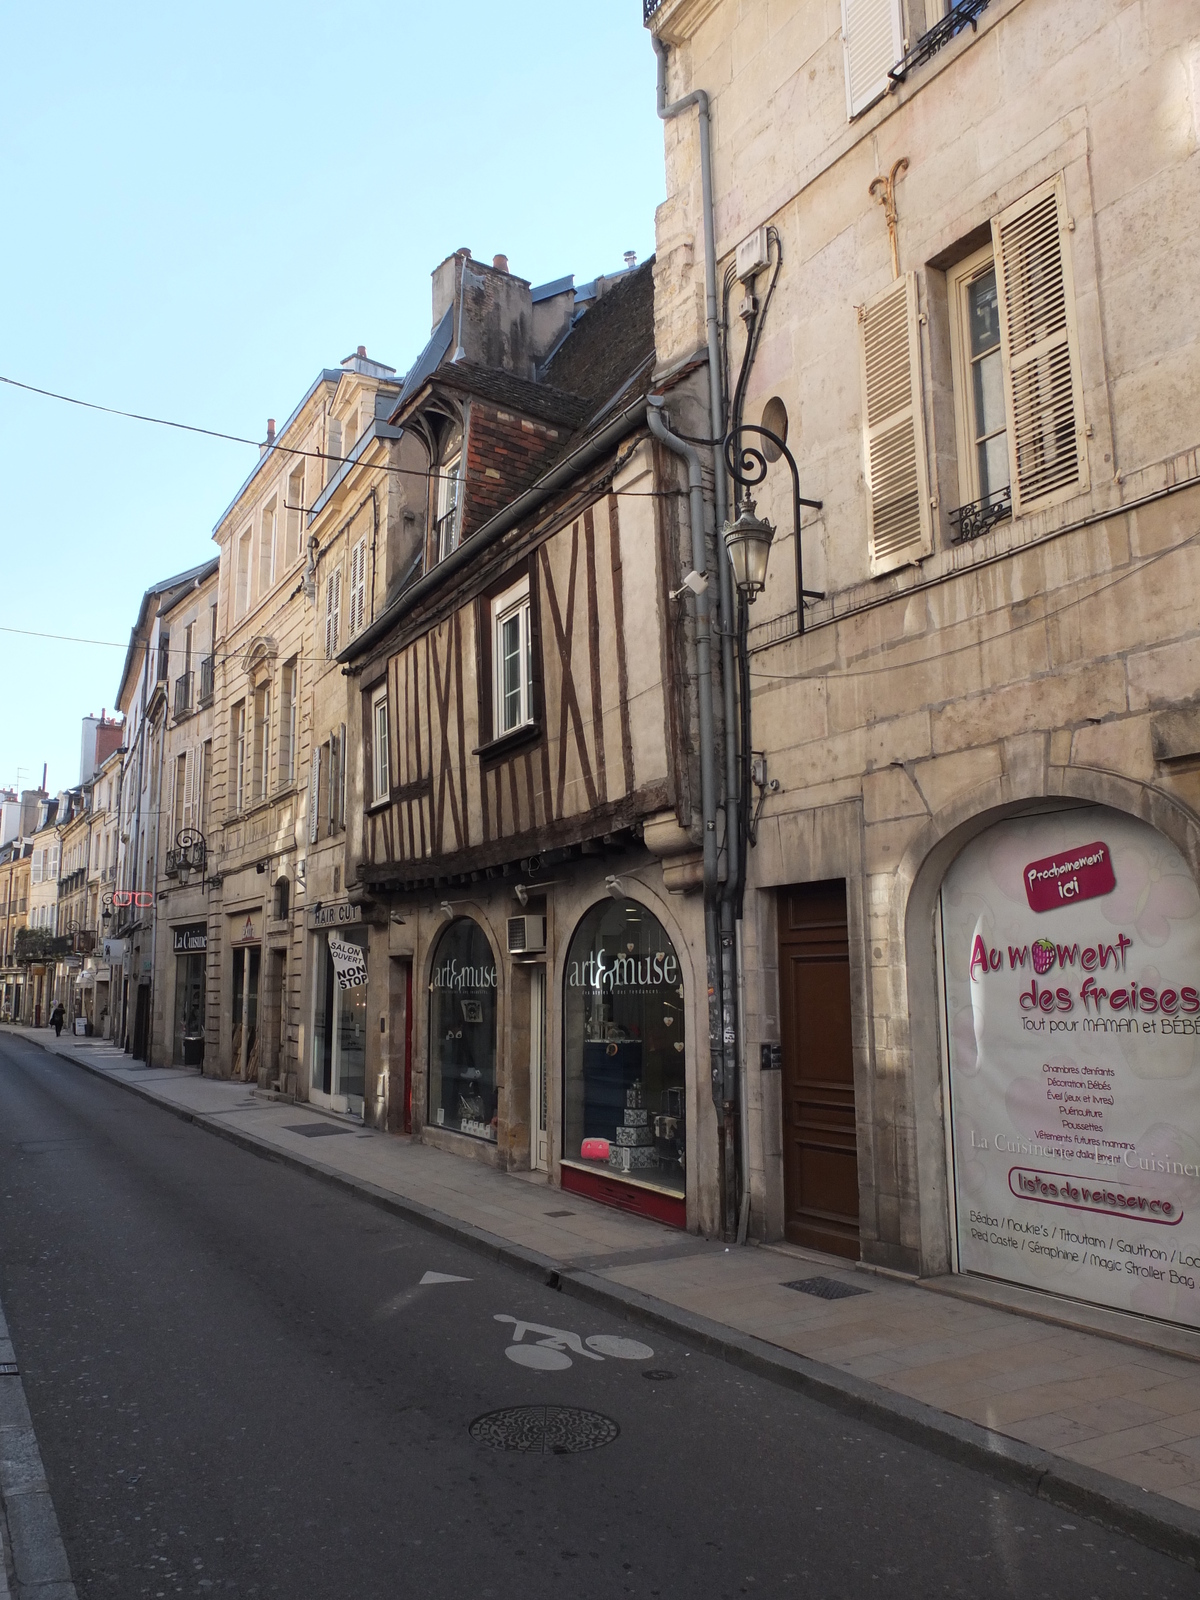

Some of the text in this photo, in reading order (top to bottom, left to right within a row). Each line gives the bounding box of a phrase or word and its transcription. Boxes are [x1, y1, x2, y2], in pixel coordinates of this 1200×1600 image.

[1027, 849, 1104, 891] Prochainement
[1057, 877, 1079, 898] ici
[315, 905, 358, 925] HAIR CUT
[174, 931, 183, 949] La
[330, 941, 360, 956] SALON
[332, 951, 362, 965] OUVERT
[970, 934, 1001, 982] Au
[336, 964, 366, 980] NON
[340, 974, 368, 990] STOP
[1019, 976, 1200, 1014] des fraises
[1021, 1016, 1045, 1031] Tout
[1049, 1020, 1079, 1033] pour
[1083, 1018, 1138, 1034] MAMAN
[1142, 1020, 1157, 1034] et
[1042, 1063, 1080, 1074] Chambres
[1047, 1077, 1111, 1091] Décoration Bébés
[1083, 1095, 1091, 1103] et
[1092, 1095, 1115, 1106] livres)
[1059, 1105, 1103, 1118] Puériculture
[1061, 1119, 1104, 1132] Poussettes
[970, 1130, 989, 1149] La
[994, 1133, 1072, 1161] Cuisinerie
[1034, 1130, 1136, 1150] Vêtements futures mamans
[1017, 1172, 1173, 1215] listes de naissance
[969, 1210, 999, 1228] Béaba
[1117, 1239, 1167, 1261] Sauthon
[970, 1227, 989, 1243] Red
[990, 1232, 1019, 1249] Castle
[1027, 1240, 1079, 1262] Séraphine
[1090, 1253, 1122, 1272] Magic
[1124, 1260, 1166, 1281] Stroller
[1169, 1269, 1195, 1289] Bag
